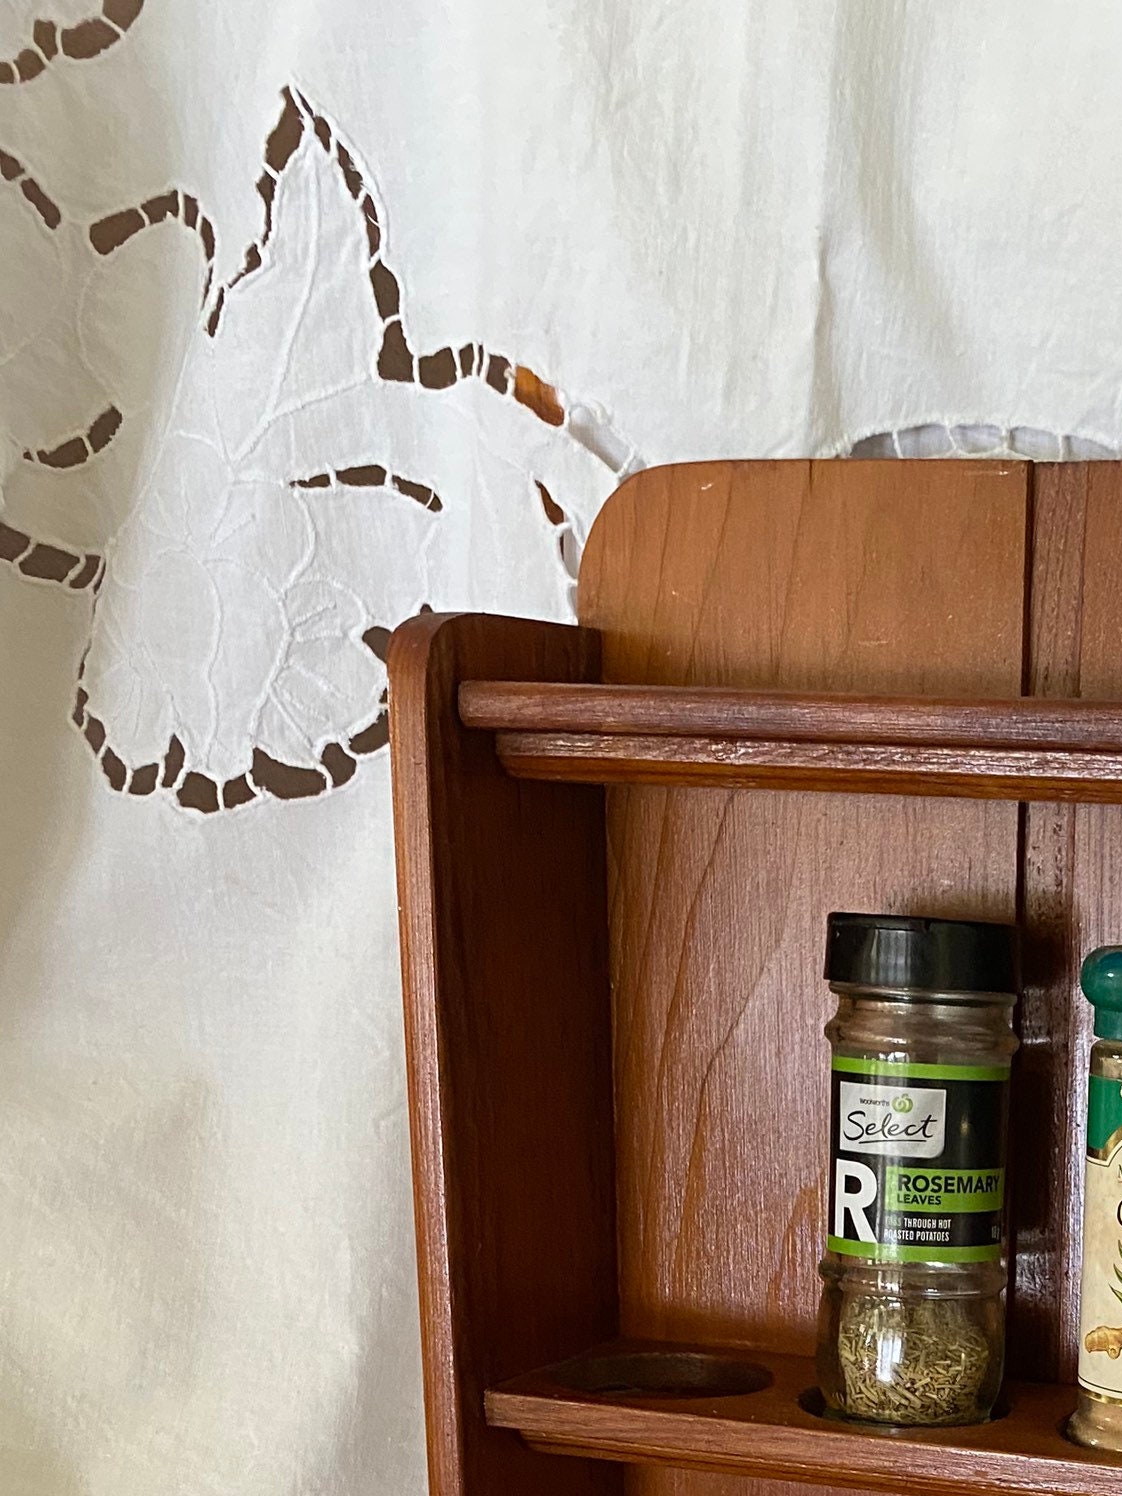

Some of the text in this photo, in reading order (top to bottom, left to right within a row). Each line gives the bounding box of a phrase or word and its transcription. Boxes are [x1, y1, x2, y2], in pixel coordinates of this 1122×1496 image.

[843, 1111, 938, 1140] Select
[897, 1174, 1000, 1194] ROSEMARY
[834, 1158, 878, 1243] R
[897, 1193, 941, 1206] LEAVES
[904, 1217, 937, 1229] THROUGH
[938, 1218, 951, 1230] HOT
[884, 1228, 950, 1242] ROASTED POTATOES
